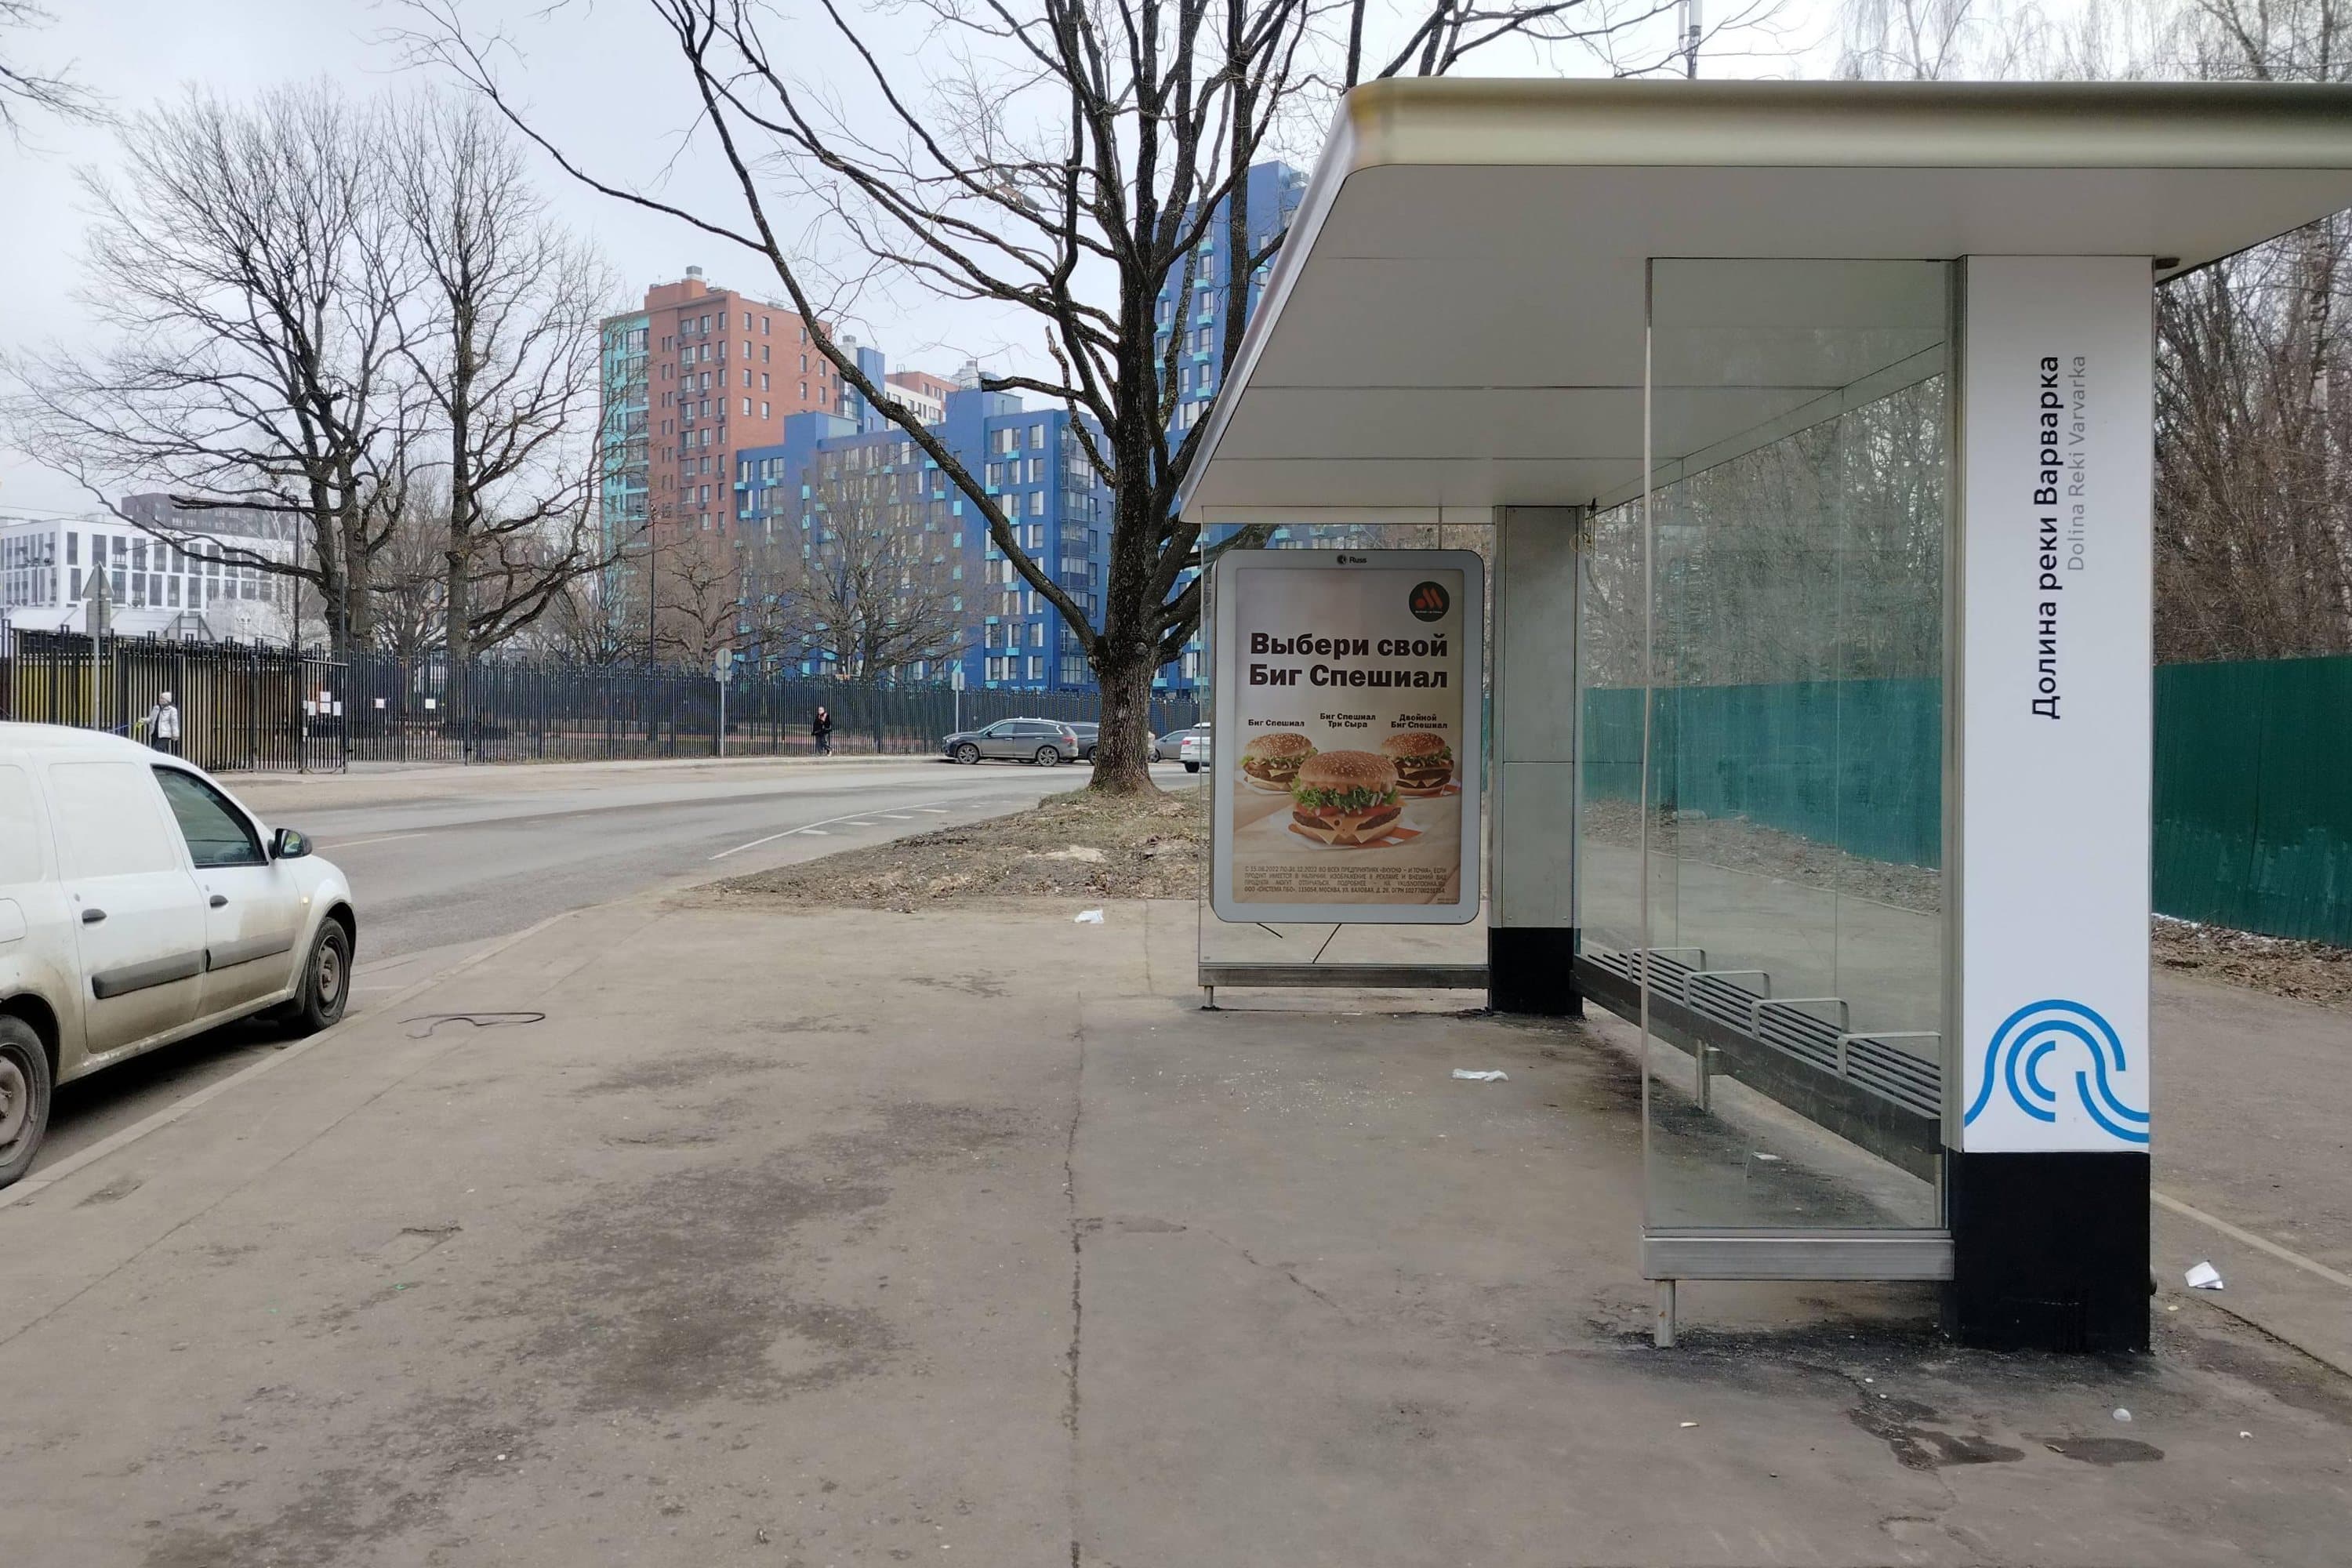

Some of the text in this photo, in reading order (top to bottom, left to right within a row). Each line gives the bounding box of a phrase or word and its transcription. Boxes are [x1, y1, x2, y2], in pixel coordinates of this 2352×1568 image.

[2067, 356, 2086, 571] Dolina Reki Varvarka
[2031, 356, 2064, 720] Долина реки Варварка
[1250, 632, 1448, 660] Выбери свой
[1250, 663, 1448, 688] Биг Спешиал
[1399, 713, 1437, 722] Двойной
